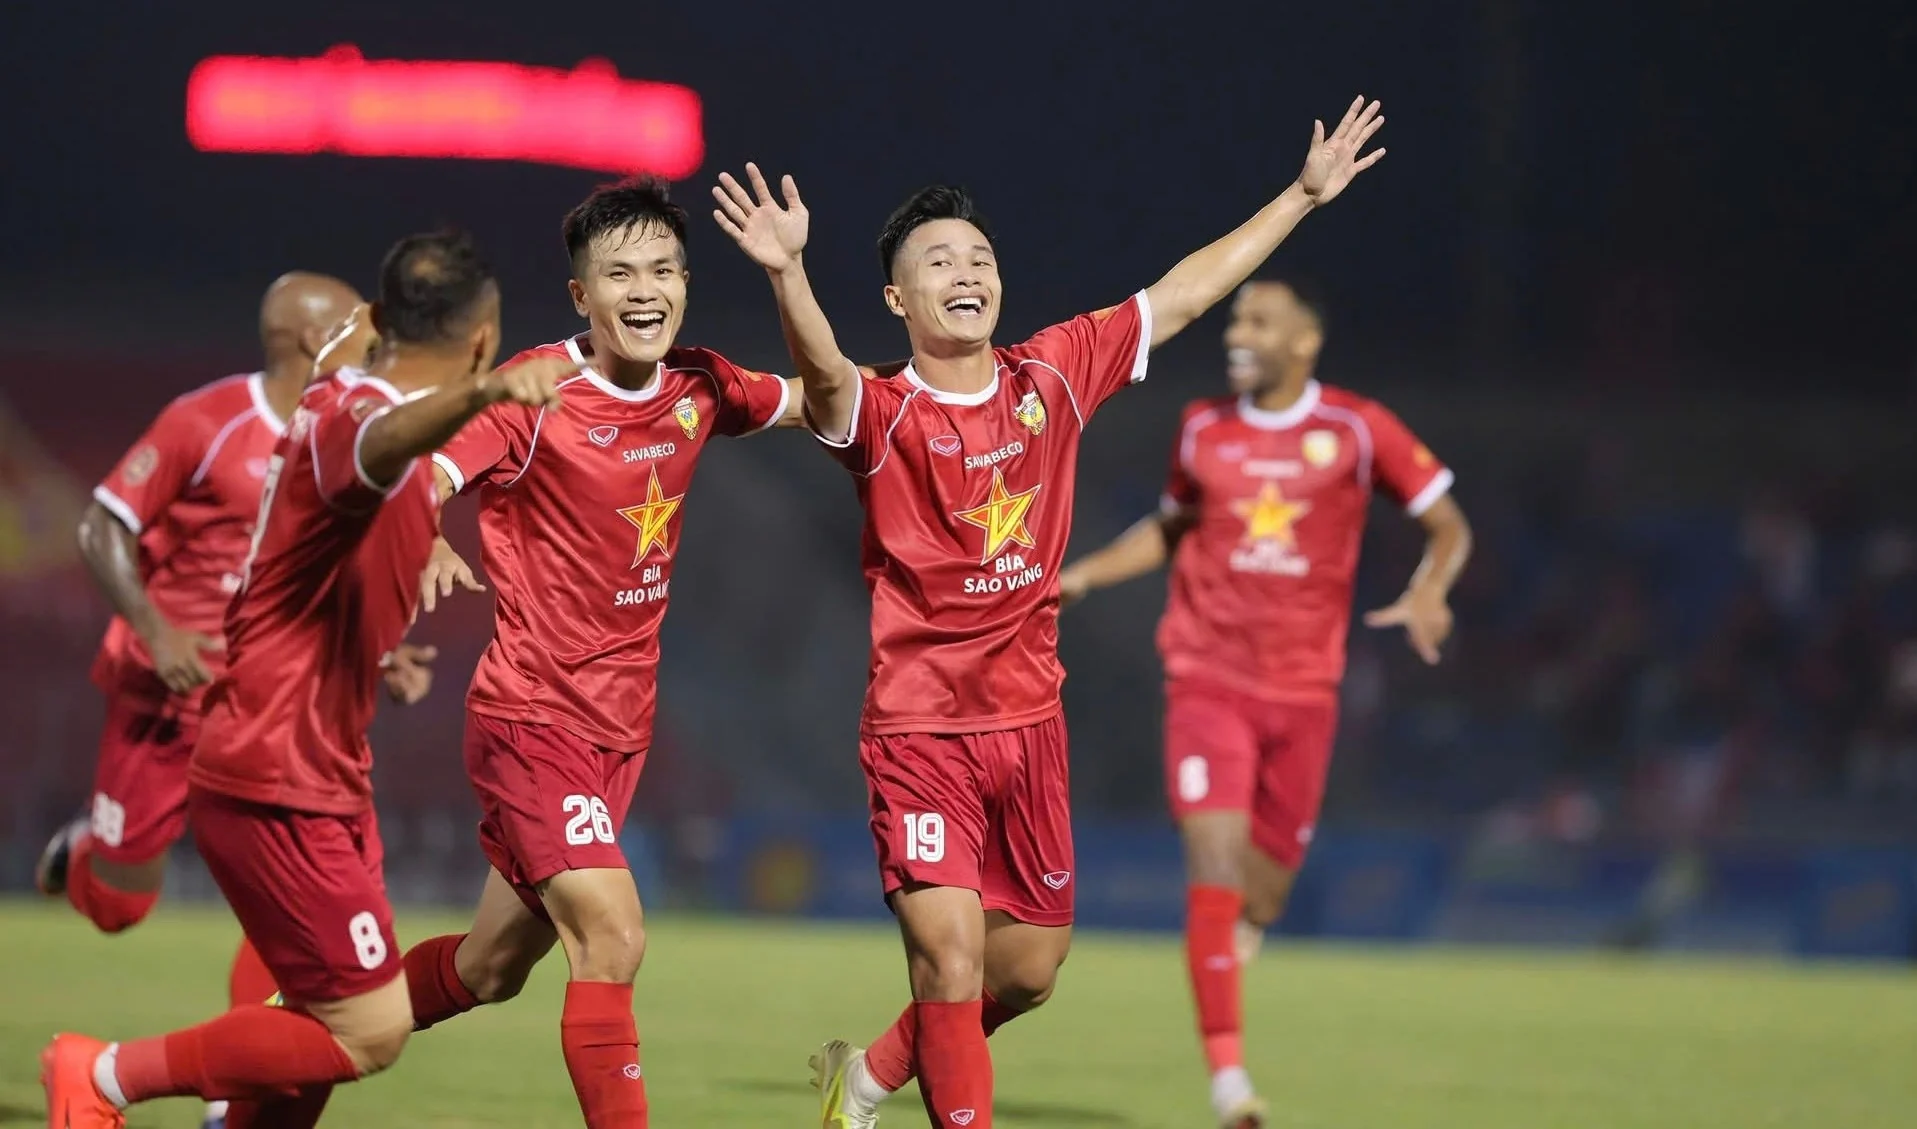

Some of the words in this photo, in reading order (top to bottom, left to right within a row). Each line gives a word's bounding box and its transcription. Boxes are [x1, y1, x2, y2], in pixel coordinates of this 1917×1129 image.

[623, 442, 676, 463] SAVABECO
[965, 441, 1024, 469] SAVABECO
[614, 588, 645, 606] SAO
[648, 579, 670, 602] VÀN
[964, 577, 1003, 594] SAO
[563, 794, 615, 845] 26
[903, 812, 945, 863] 19
[349, 910, 388, 970] 8
